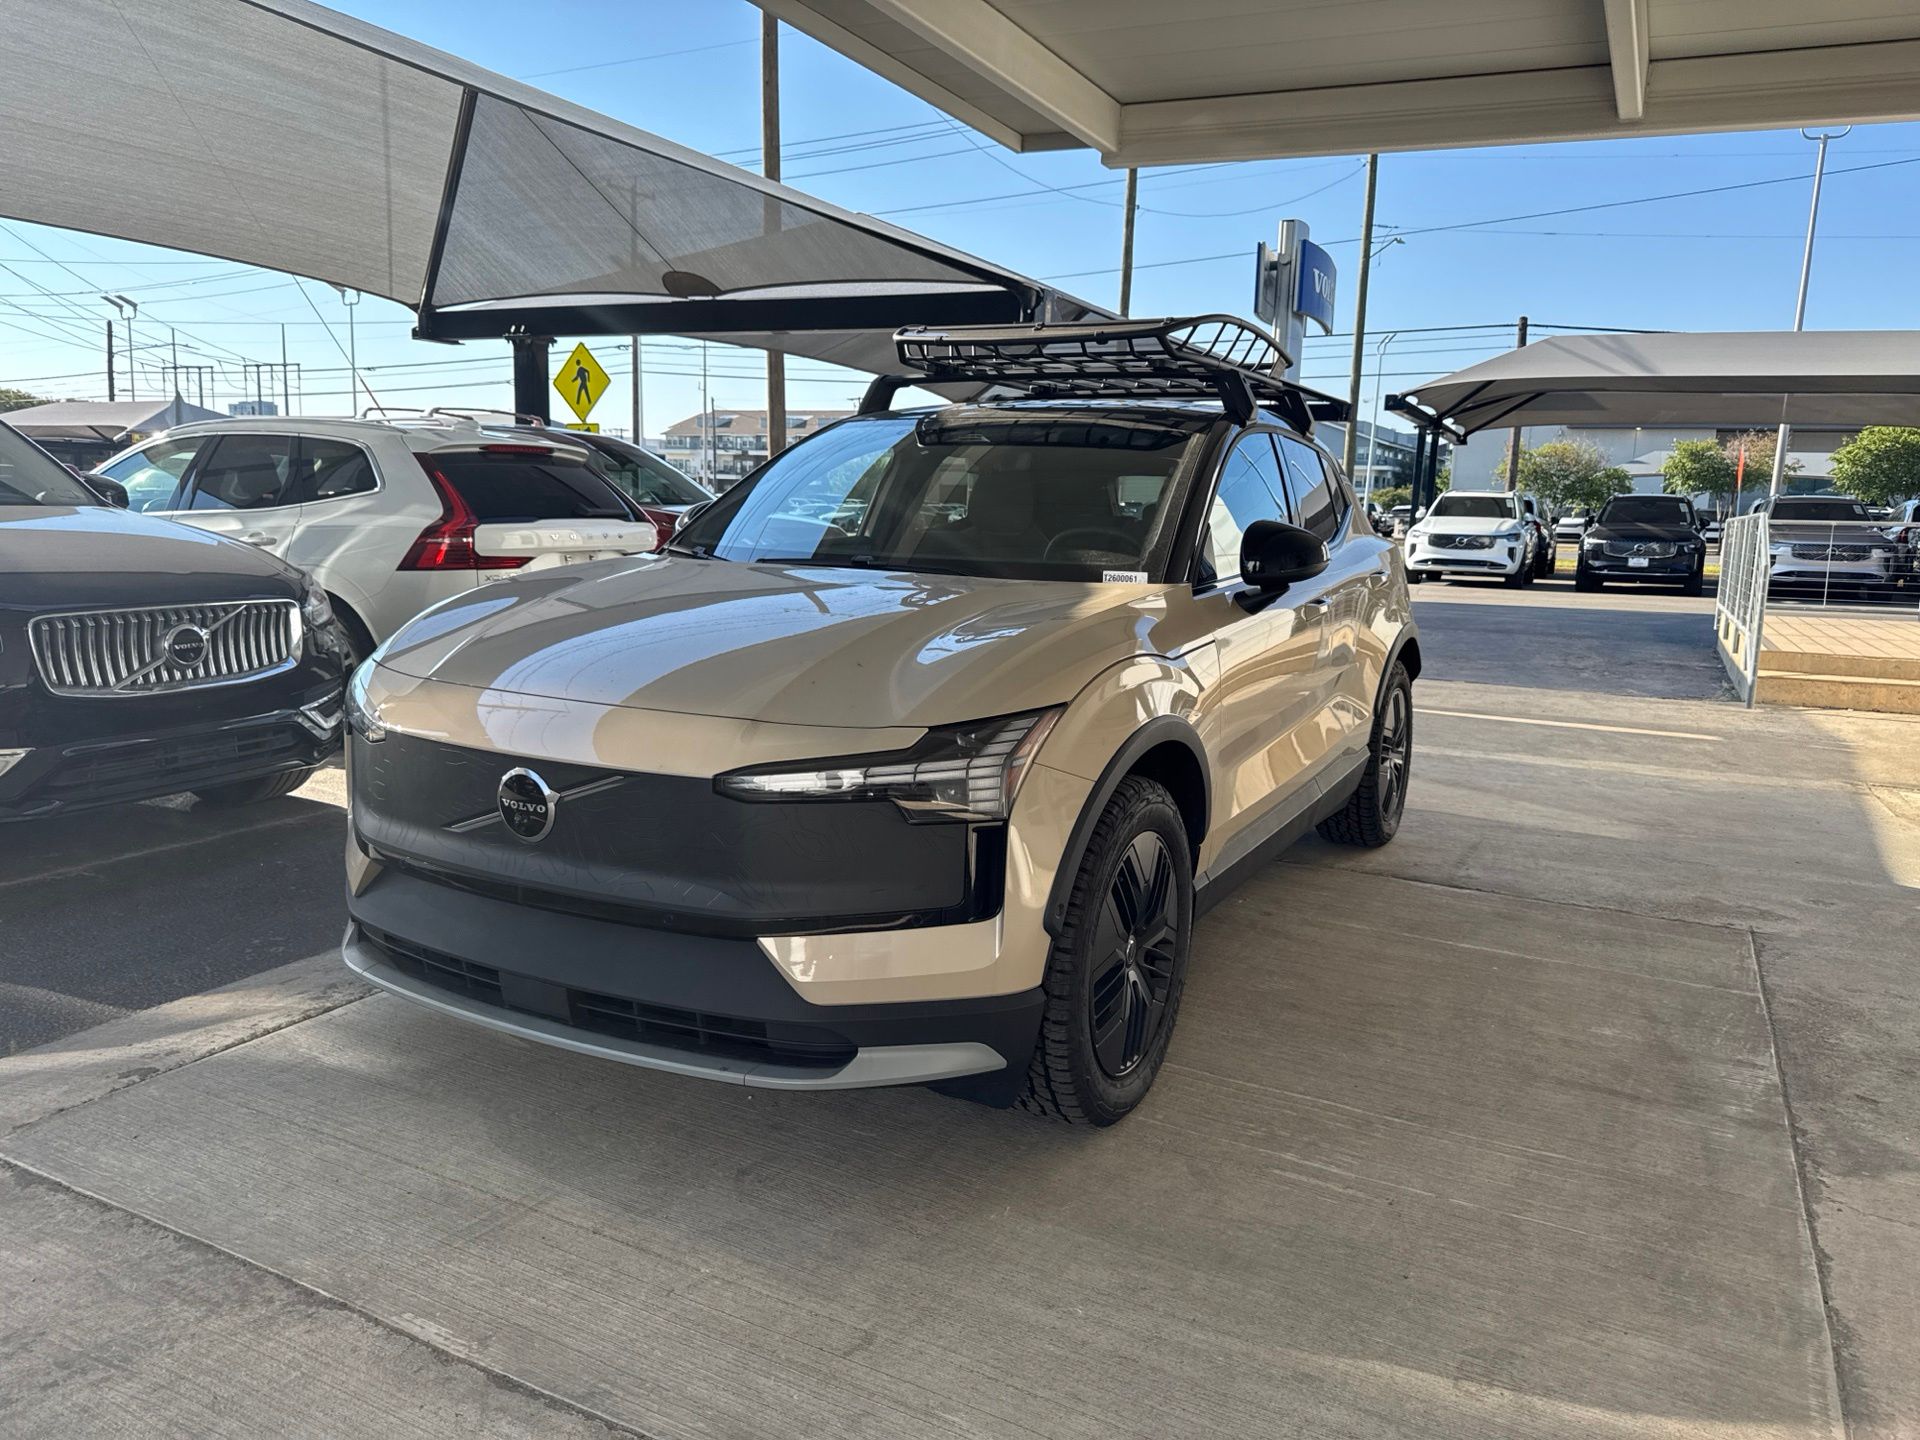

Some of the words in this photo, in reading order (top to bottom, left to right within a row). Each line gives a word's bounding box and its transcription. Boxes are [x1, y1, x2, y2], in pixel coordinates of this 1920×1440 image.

[1104, 574, 1138, 583] T2600061
[174, 642, 204, 650] VOLVO
[501, 798, 546, 813] VOLVO
